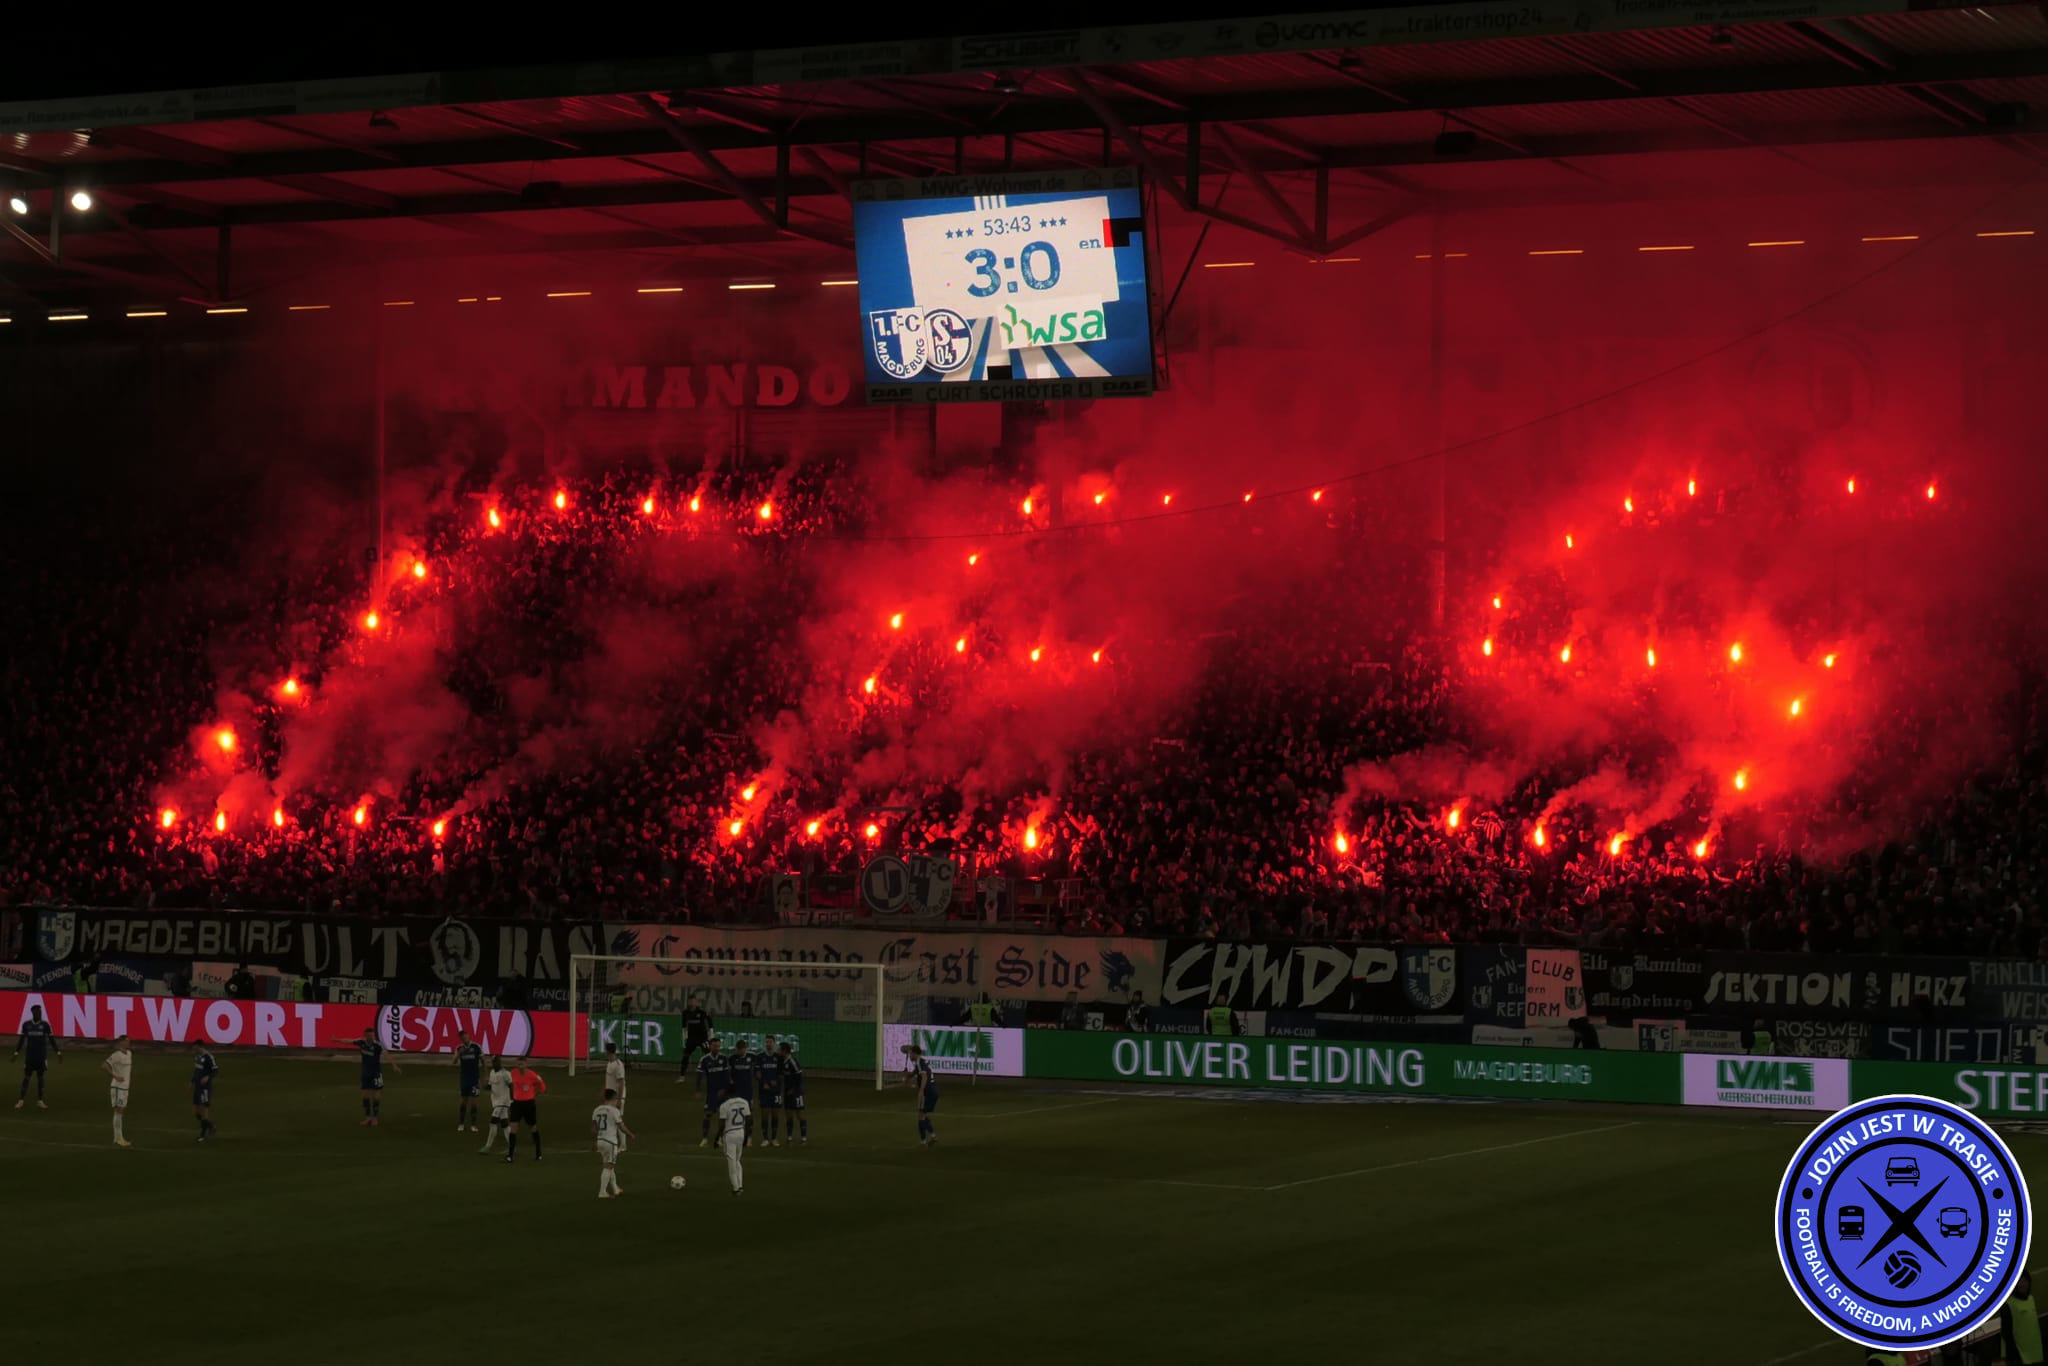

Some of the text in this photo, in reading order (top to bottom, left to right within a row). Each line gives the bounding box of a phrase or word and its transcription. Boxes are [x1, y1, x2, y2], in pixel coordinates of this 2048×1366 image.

[920, 176, 1066, 196] MWG-Wohnen.de
[983, 215, 1032, 236] 53:43
[1079, 238, 1102, 249] en
[964, 240, 1061, 298] 3:0
[875, 314, 921, 336] 1.FC
[1032, 309, 1105, 345] wsa
[877, 337, 926, 375] MAGDEBURG
[935, 345, 953, 365] 04
[588, 362, 851, 408] MANDO
[925, 381, 1072, 401] CURT SCHRÖTER
[79, 919, 294, 957] MAGDEBURG
[0, 966, 31, 985] HAUSEN
[651, 934, 1092, 990] Commando East Side
[1405, 954, 1453, 975] 1.FC
[1581, 952, 1609, 971] Elb
[1161, 942, 1398, 1010] CHWDP
[1703, 970, 1853, 1009] SEKTION
[1407, 977, 1453, 1007] MAGDEBURG
[1591, 992, 1694, 1011] Magdeburg
[16, 992, 323, 1049] ANTWORT
[1496, 1001, 1561, 1018] REFORM
[385, 1004, 401, 1050] radio
[400, 1006, 514, 1056] SAW
[589, 1018, 665, 1057] KER
[1154, 1022, 1201, 1035] FAN-CLUB
[1270, 1026, 1318, 1039] FAN-CLUB
[1111, 1037, 1426, 1088] OLIVER LEIDING
[1453, 1058, 1593, 1086] MAGDEBURG
[731, 1108, 746, 1126] 25
